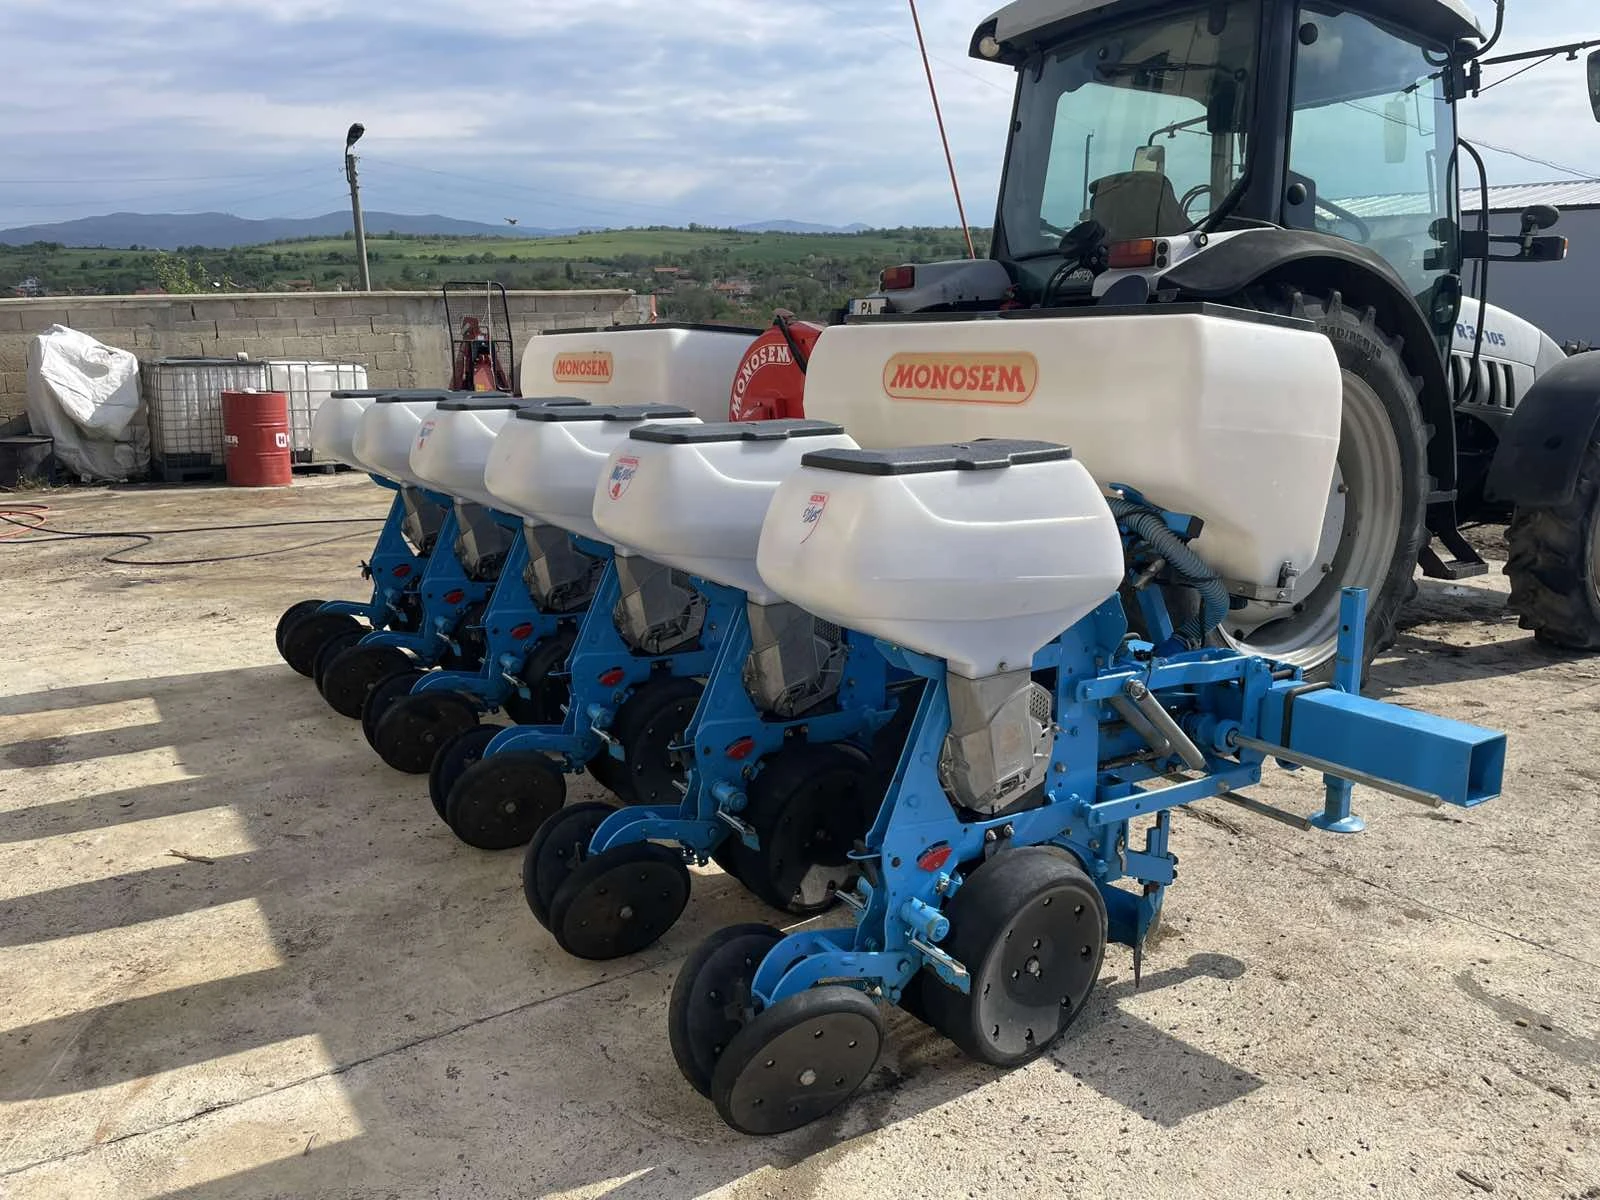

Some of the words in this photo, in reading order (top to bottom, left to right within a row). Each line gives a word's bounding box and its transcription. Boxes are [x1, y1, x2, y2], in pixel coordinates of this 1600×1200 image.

[861, 301, 873, 316] PA
[1484, 330, 1506, 346] 105
[556, 359, 609, 377] MONOSEM
[732, 346, 791, 418] MONOSEM
[889, 363, 1026, 393] MONOSEM
